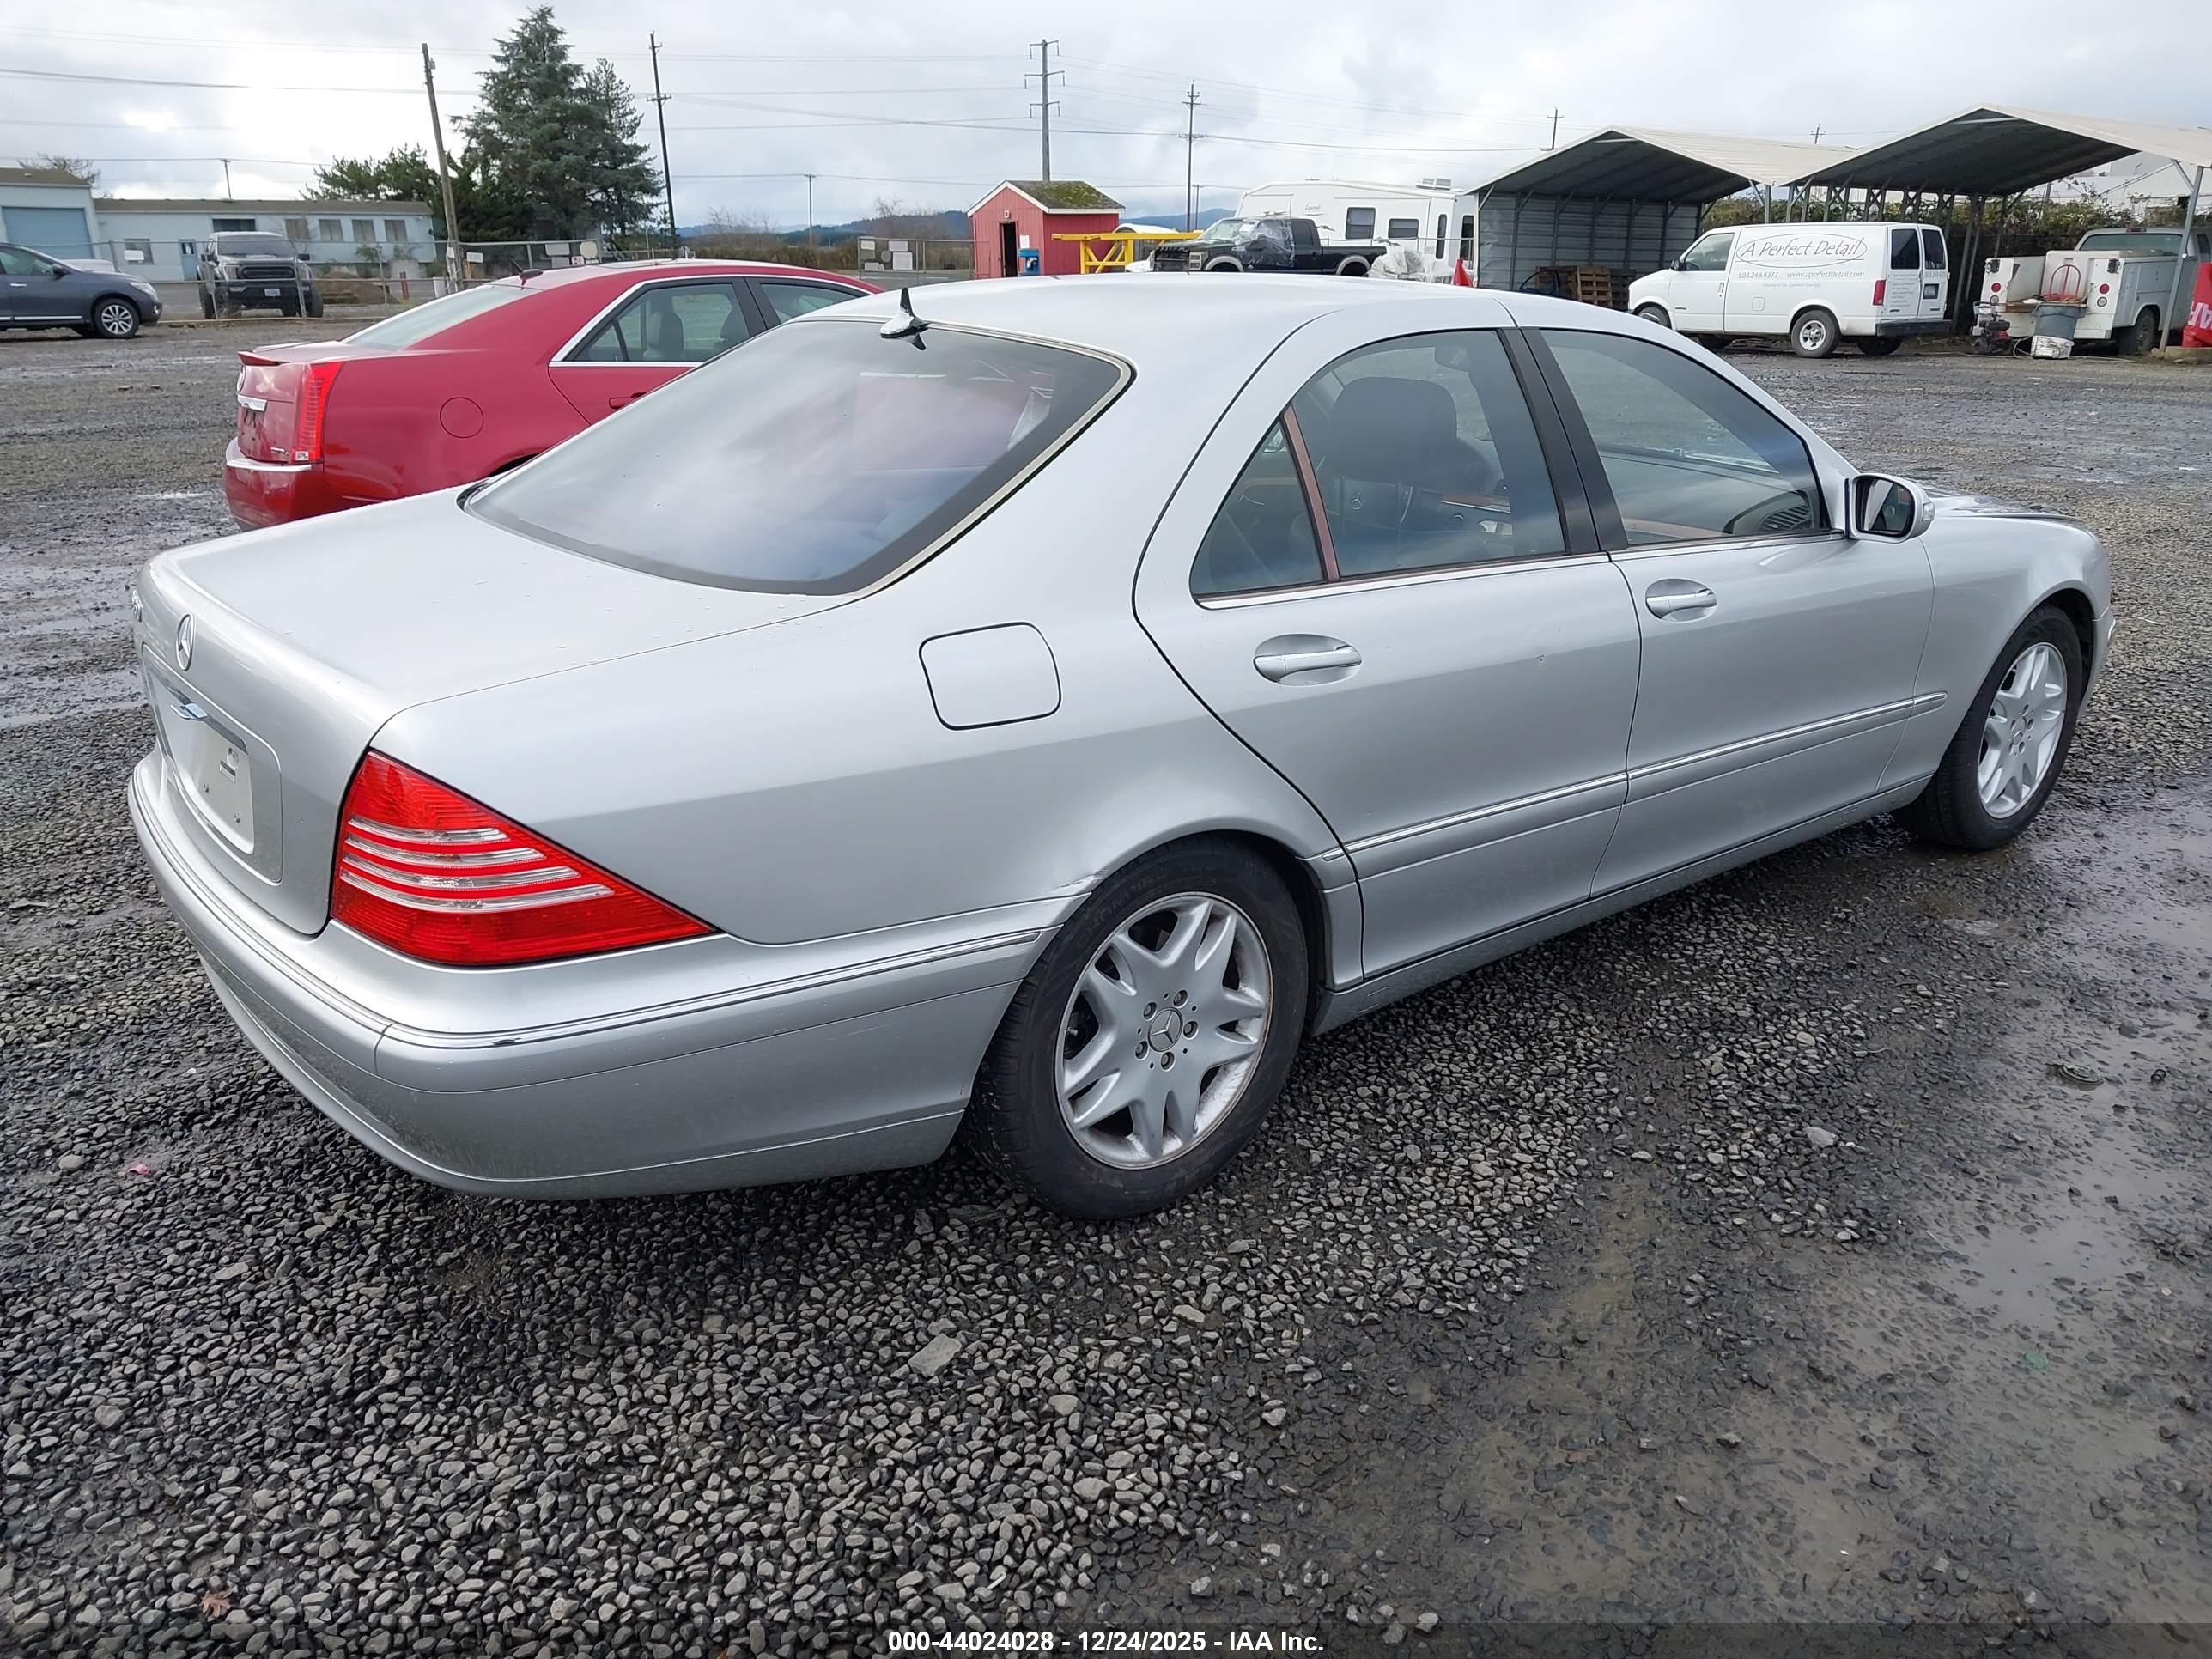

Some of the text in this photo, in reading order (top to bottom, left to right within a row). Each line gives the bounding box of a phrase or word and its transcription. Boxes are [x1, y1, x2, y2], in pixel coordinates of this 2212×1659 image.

[1741, 237, 1864, 257] A Perfect Detail
